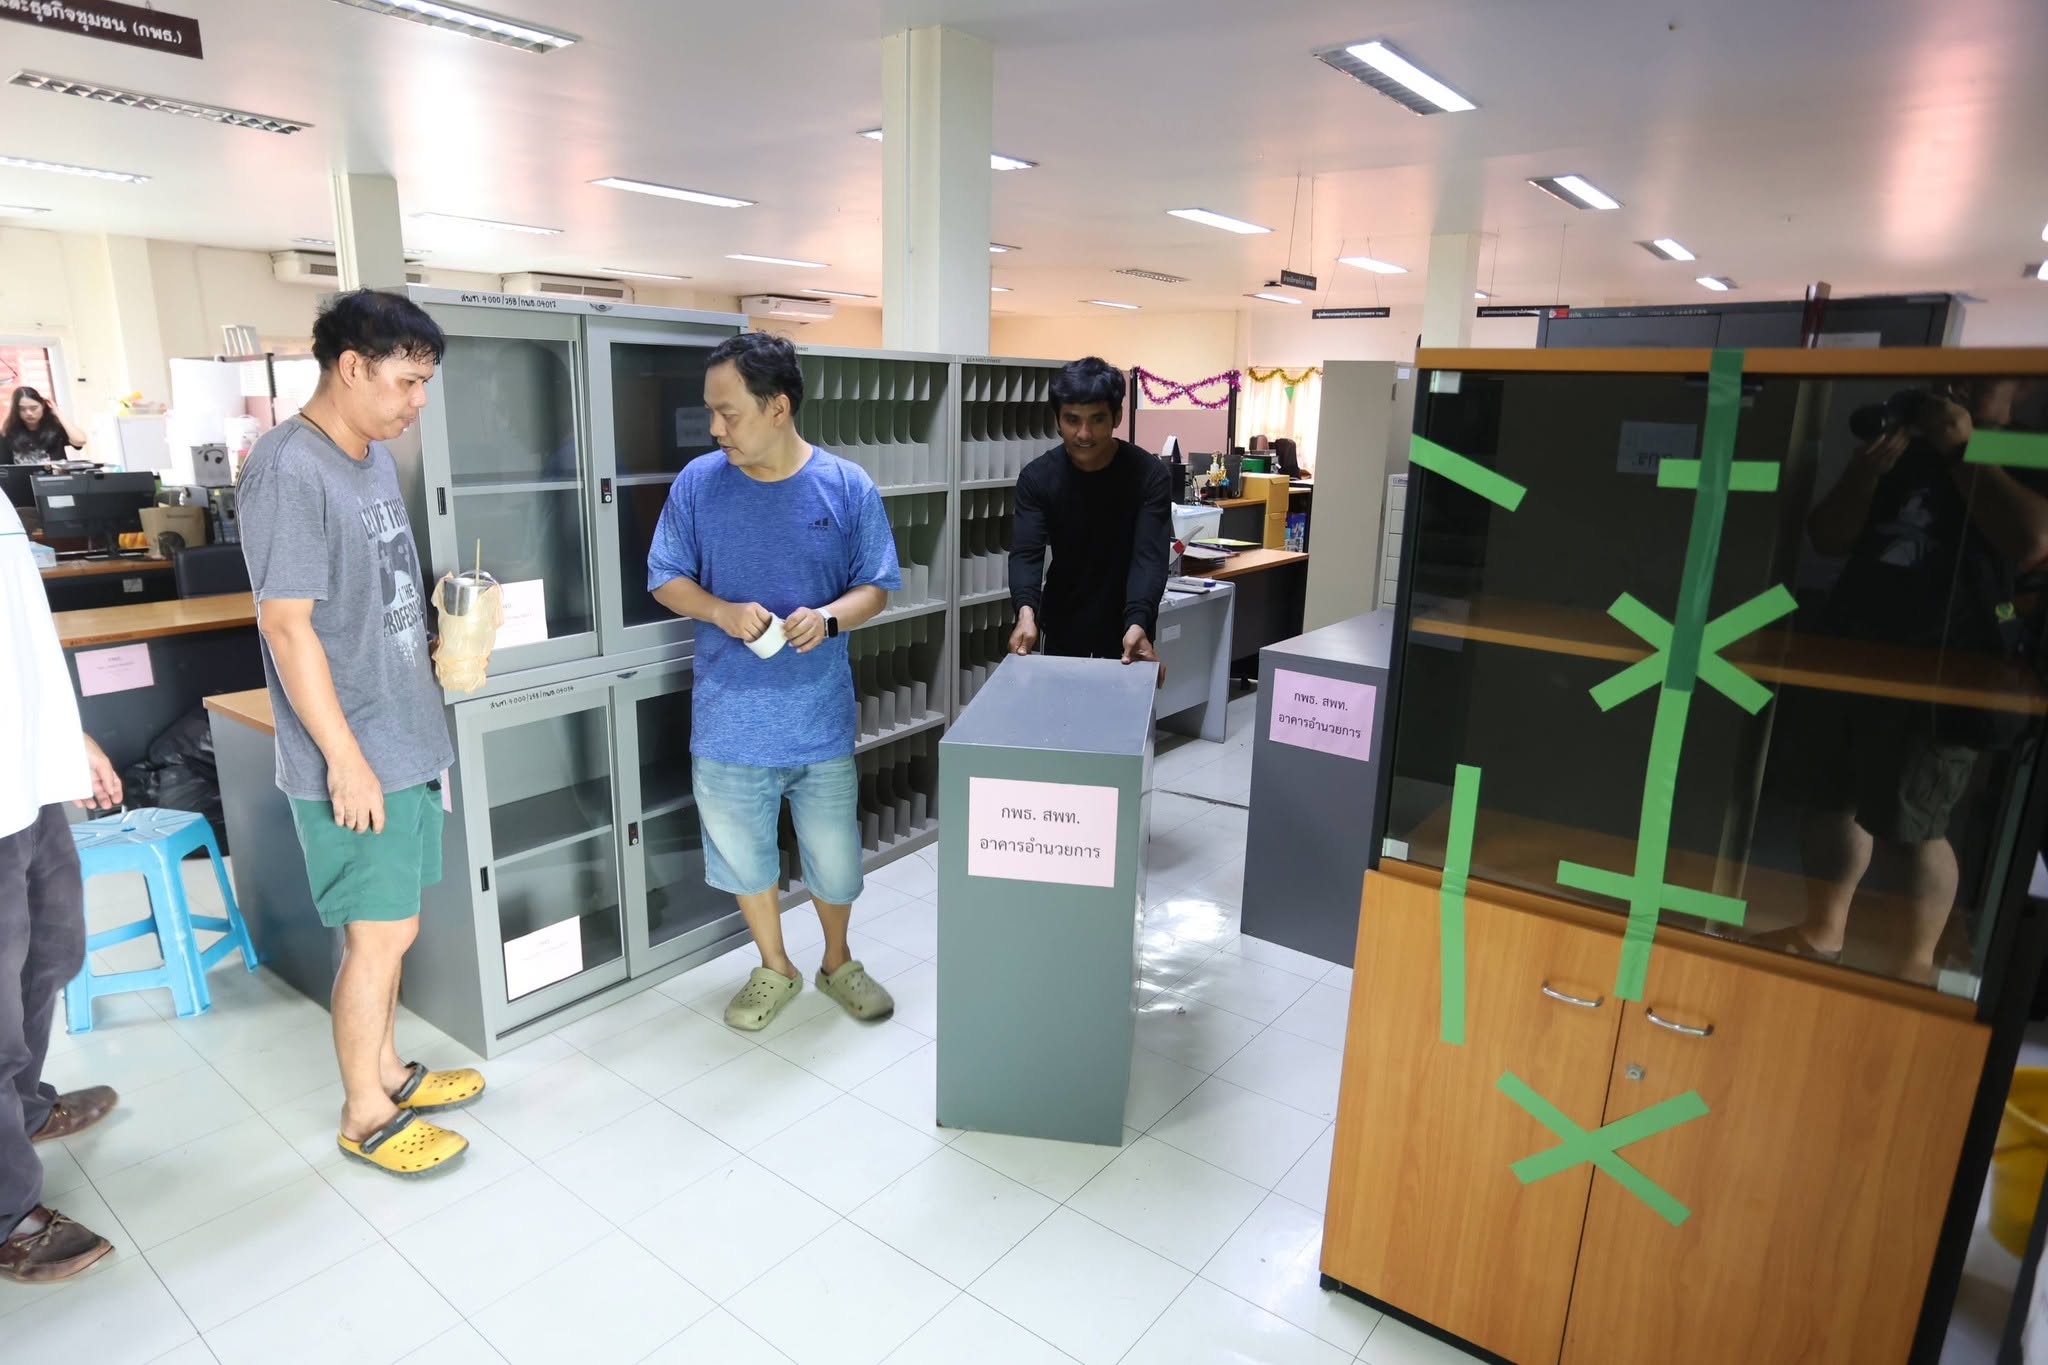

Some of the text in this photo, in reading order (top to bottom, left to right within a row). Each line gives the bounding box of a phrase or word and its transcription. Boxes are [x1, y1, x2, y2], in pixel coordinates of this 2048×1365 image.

[132, 21, 182, 45] (กพธ.)
[1293, 692, 1348, 711] กพธ. สพท.
[1278, 713, 1361, 739] อาคารอำนวยการ
[1001, 806, 1081, 825] กพธ. สพท.
[979, 836, 1101, 859] อาคารอำนวยการ
